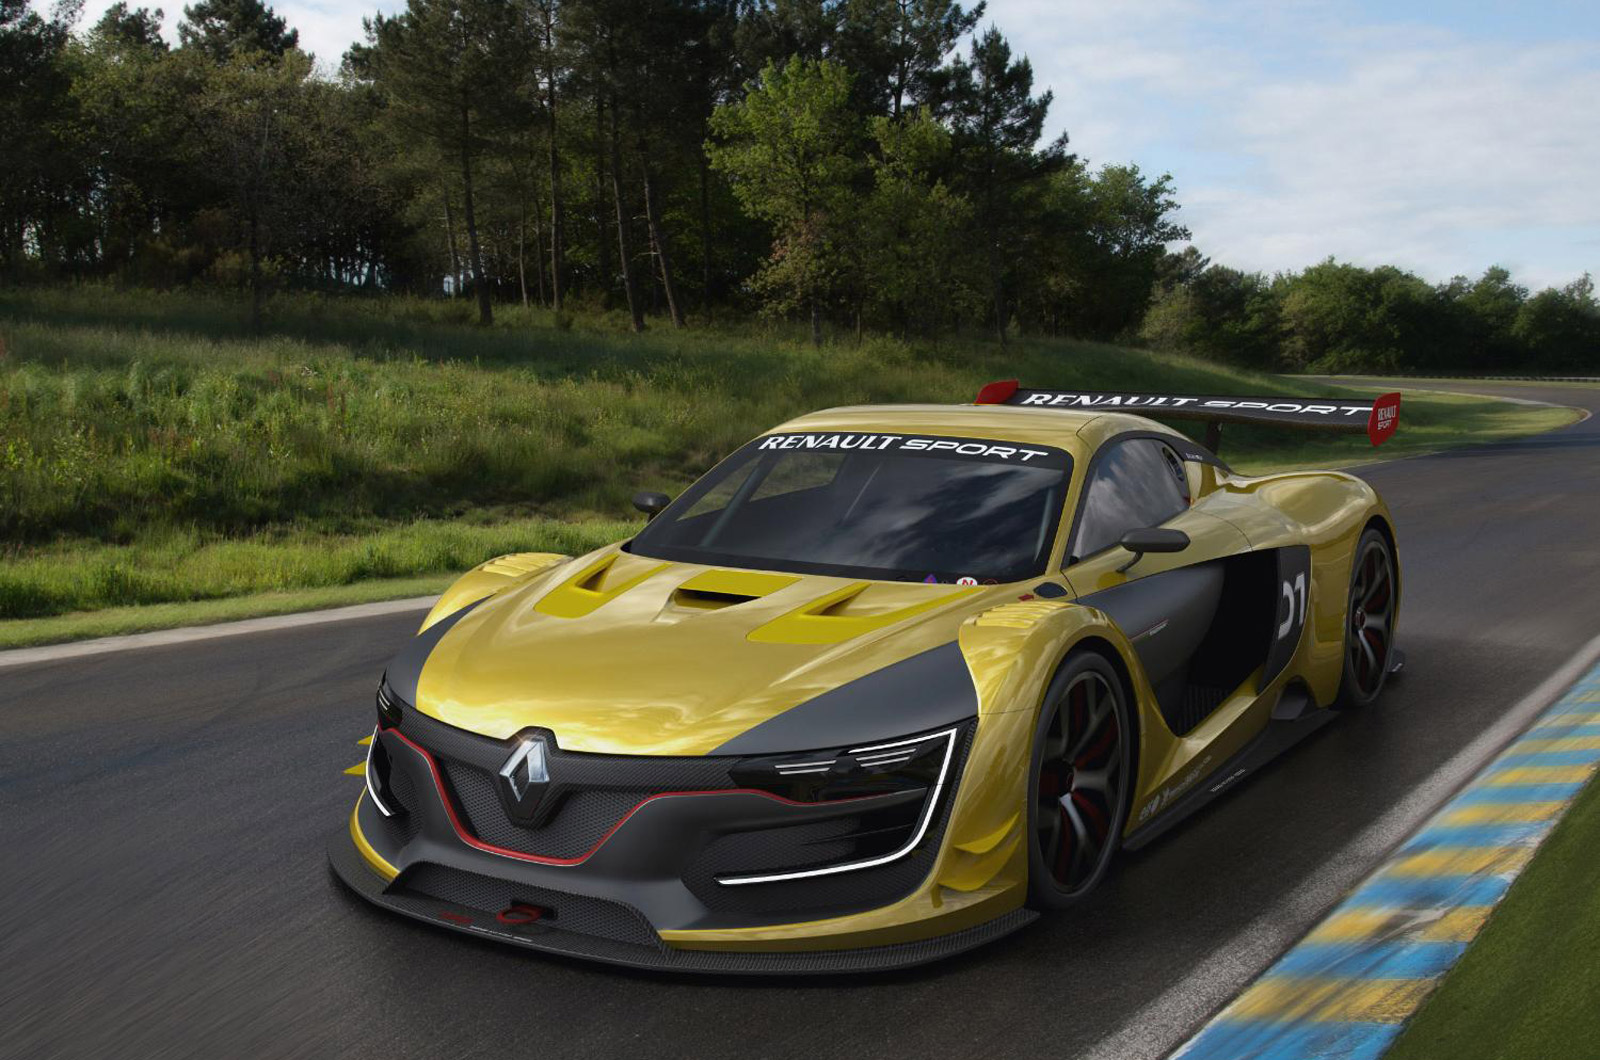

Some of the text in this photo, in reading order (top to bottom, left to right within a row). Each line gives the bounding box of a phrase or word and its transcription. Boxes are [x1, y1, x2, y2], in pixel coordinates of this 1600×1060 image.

[1022, 394, 1373, 415] RENAULT SPORT
[759, 435, 1049, 461] RENAULT SPORT
